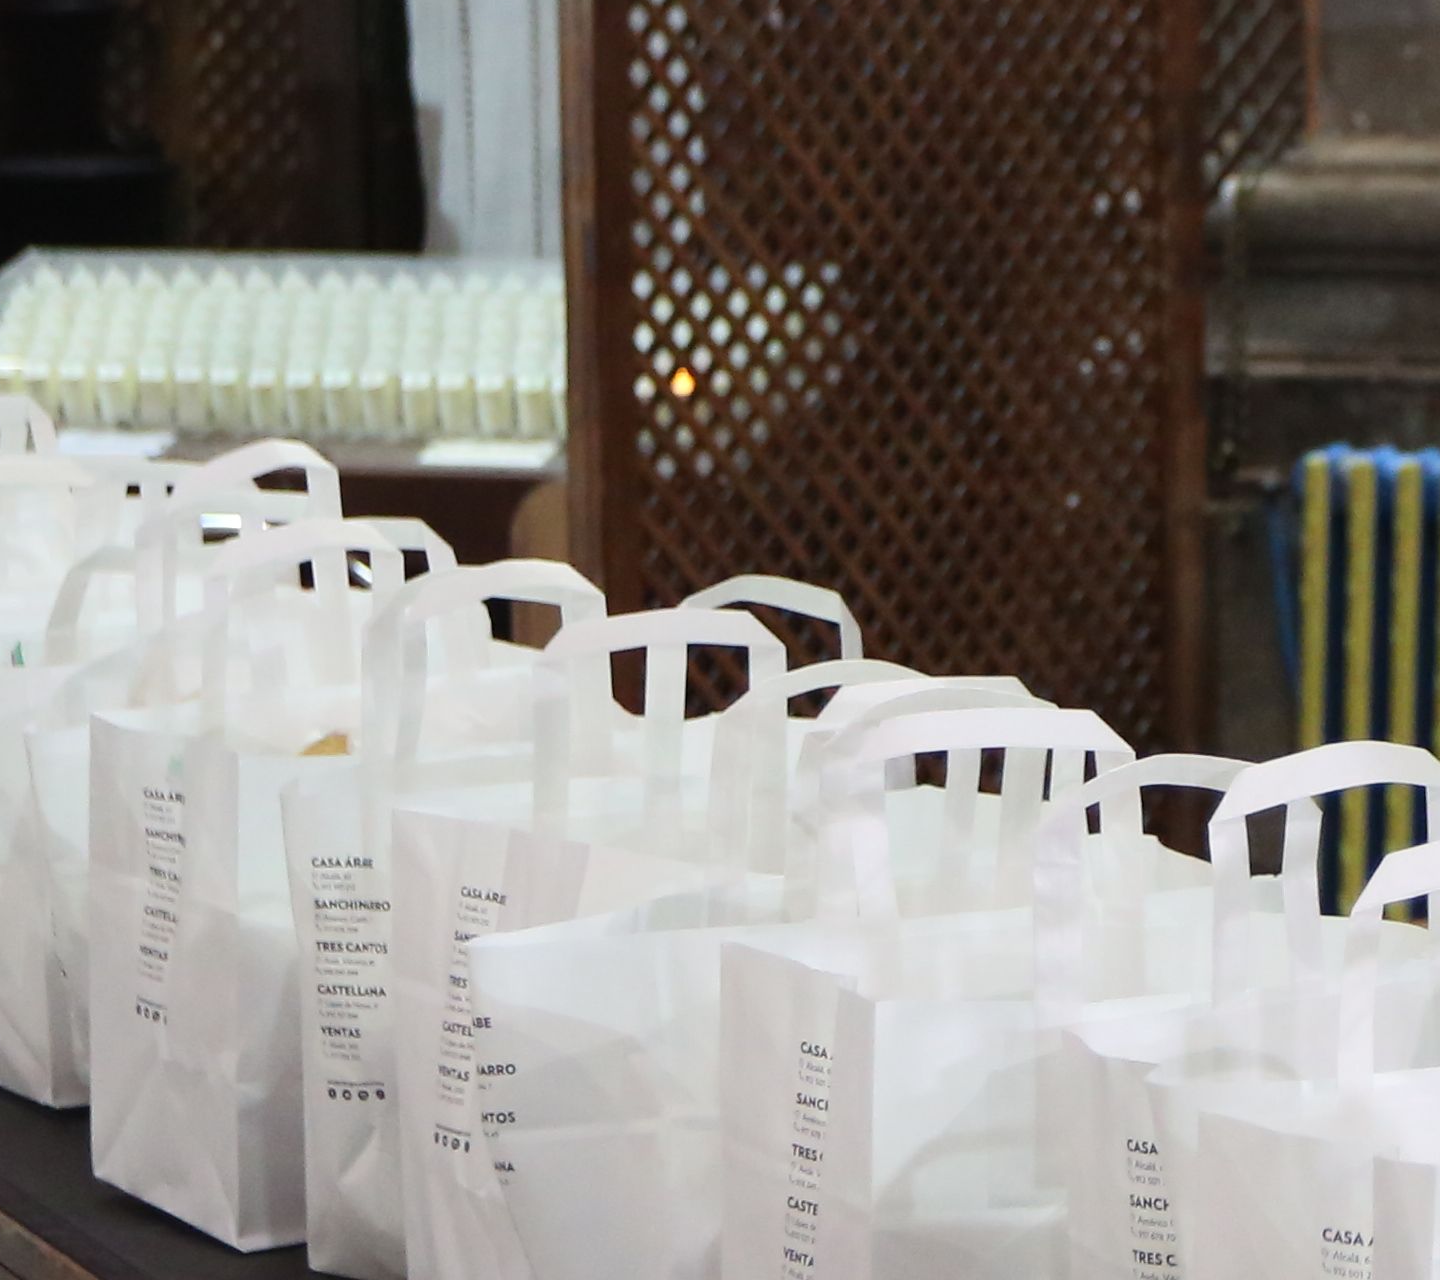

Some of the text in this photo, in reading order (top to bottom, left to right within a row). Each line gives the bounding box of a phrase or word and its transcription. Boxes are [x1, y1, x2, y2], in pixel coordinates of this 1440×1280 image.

[311, 857, 342, 869] CASA
[460, 886, 482, 900] CASA
[316, 941, 389, 955] TRES CANTOS
[321, 1024, 362, 1038] VENTAS
[800, 1040, 828, 1059] CASA
[792, 1142, 817, 1162] TRES
[1126, 1138, 1159, 1156] CASA
[1321, 1227, 1364, 1247] CASA
[1132, 1249, 1163, 1267] TRES
